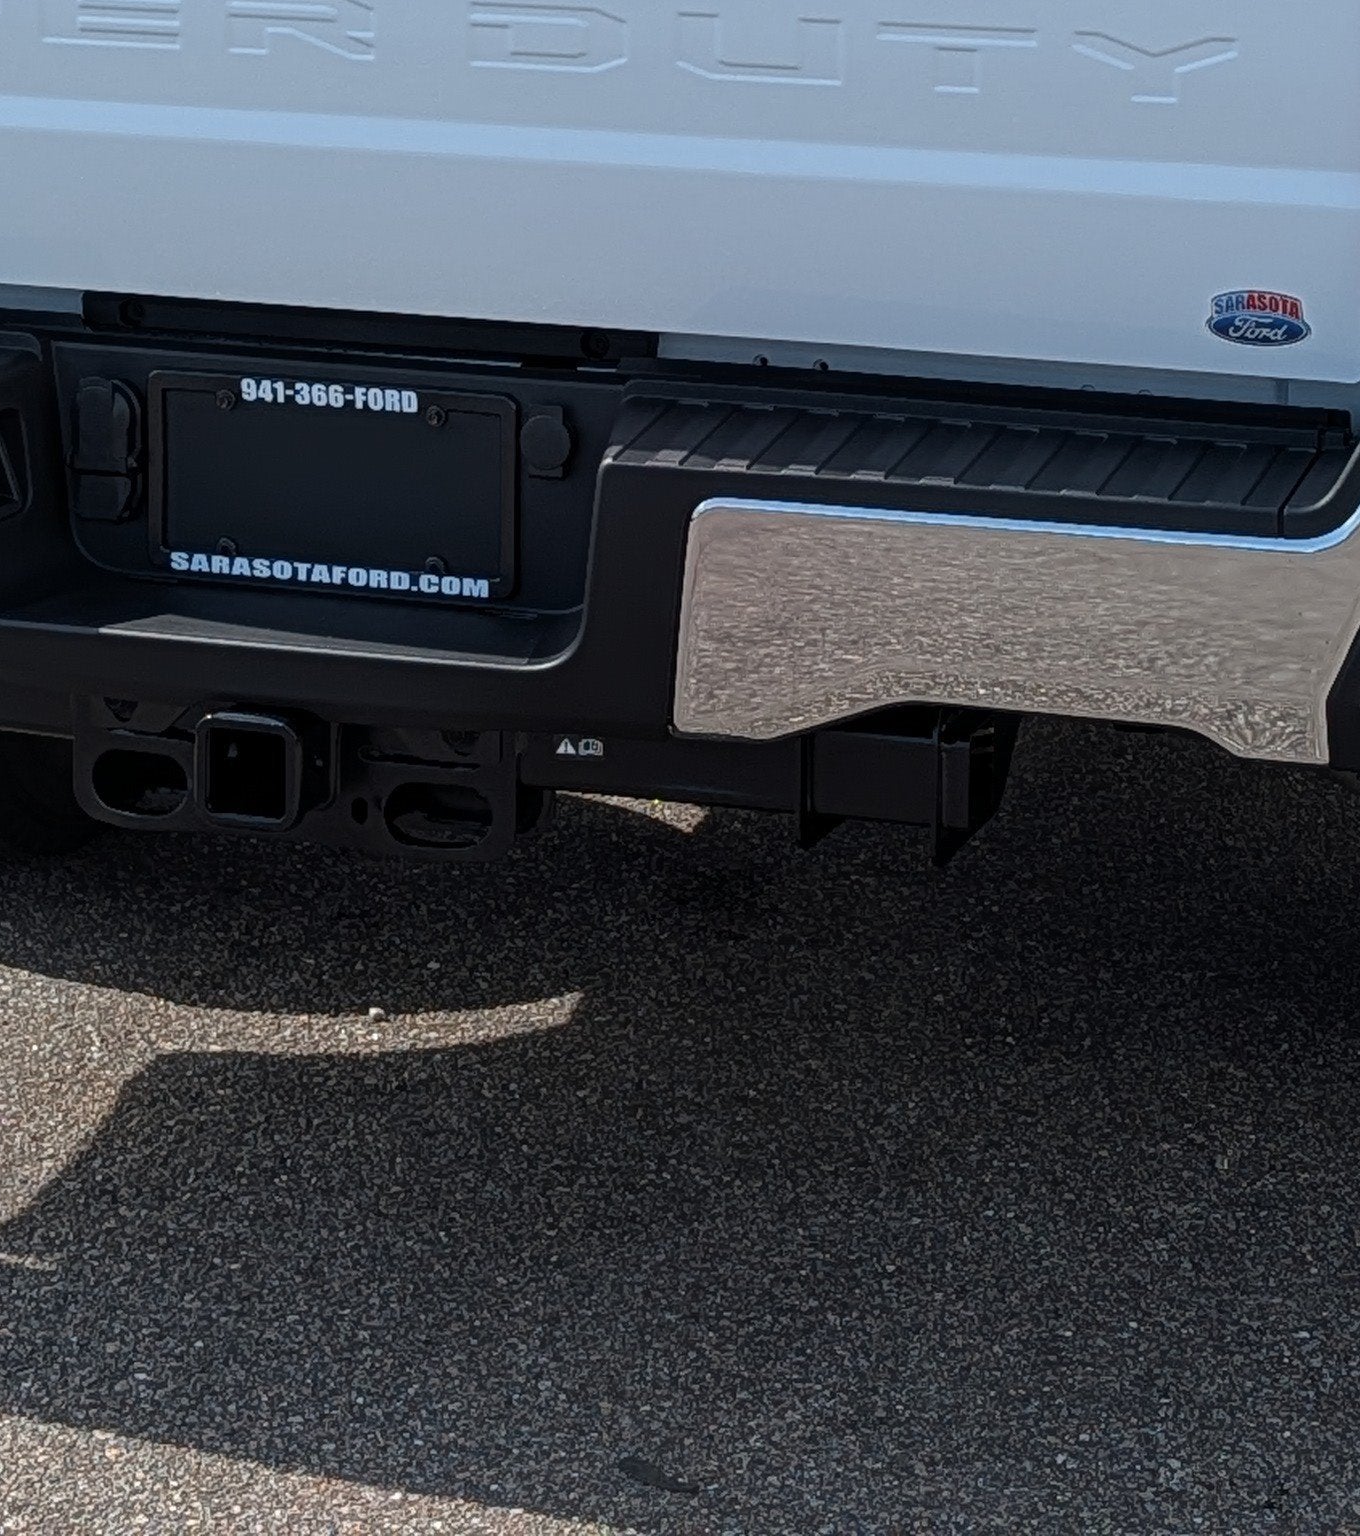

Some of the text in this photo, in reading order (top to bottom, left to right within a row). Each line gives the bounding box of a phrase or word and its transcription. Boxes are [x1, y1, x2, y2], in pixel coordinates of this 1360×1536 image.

[468, 1, 1239, 103] DUTY
[1214, 294, 1301, 319] SARASOTA
[1228, 316, 1288, 341] Ford
[241, 378, 419, 413] 941-366-FORD
[170, 551, 489, 598] SARASOTAFORD.COM
